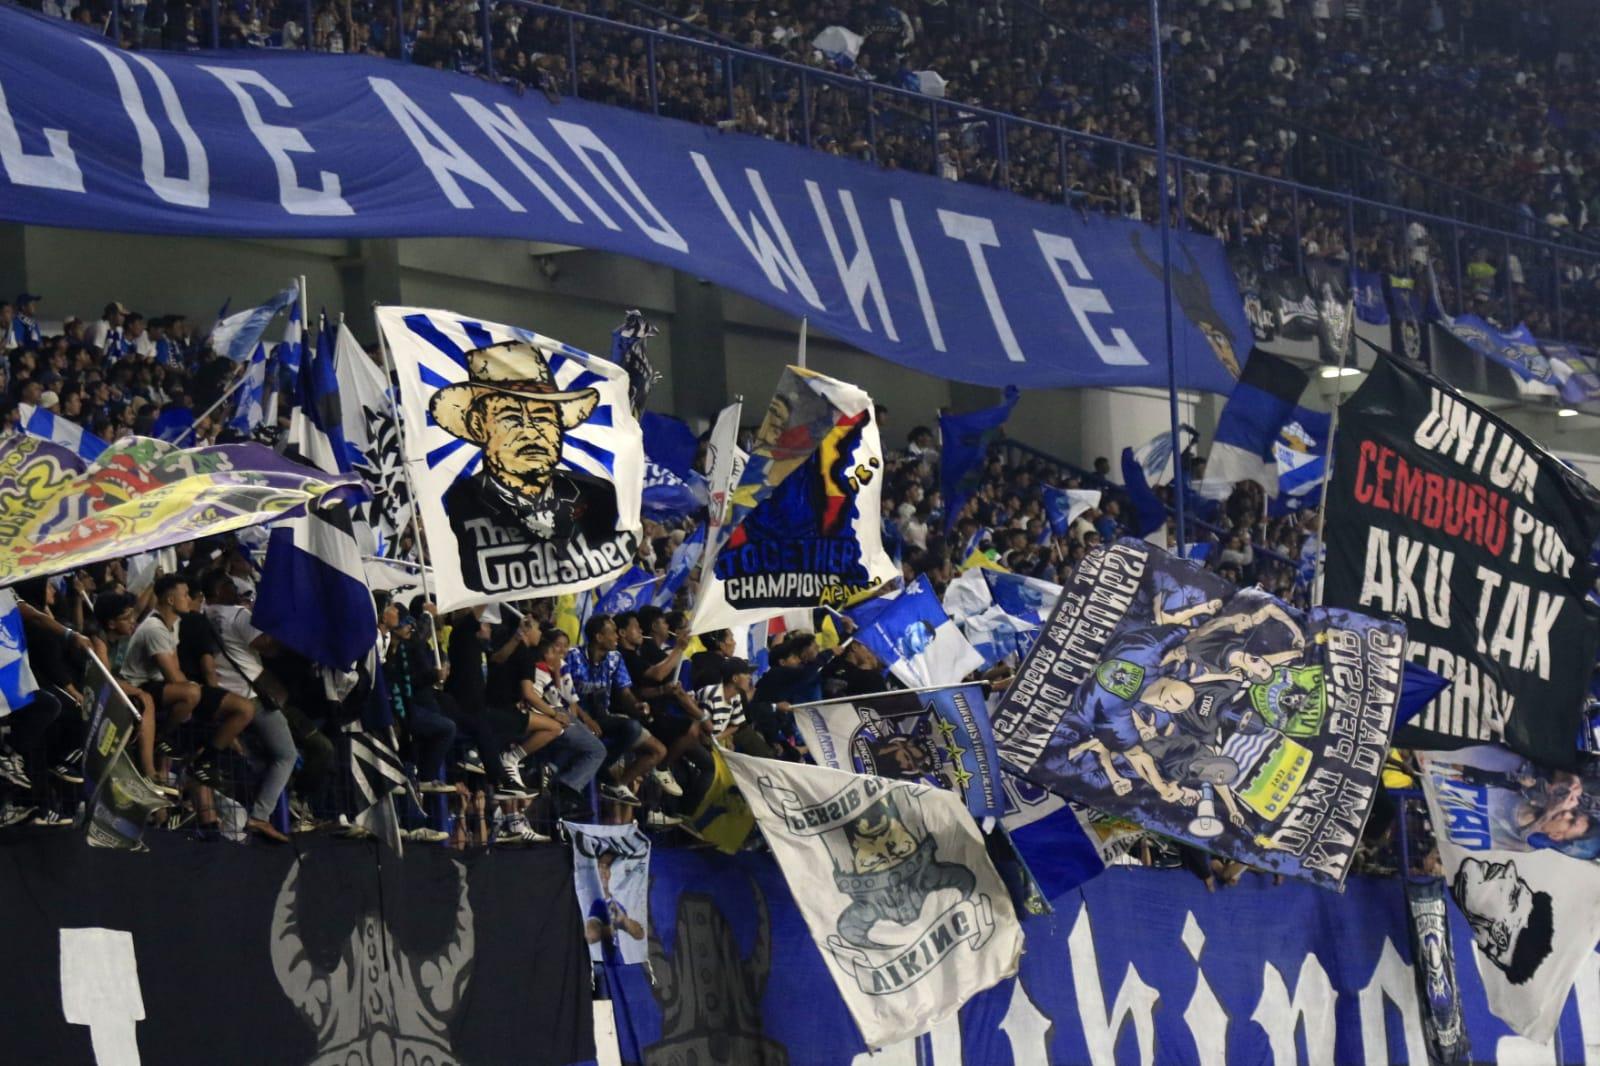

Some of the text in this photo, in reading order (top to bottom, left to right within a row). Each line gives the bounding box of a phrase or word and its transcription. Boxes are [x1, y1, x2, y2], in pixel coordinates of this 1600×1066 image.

[367, 76, 689, 253] AND
[689, 151, 1149, 365] WHITE
[464, 517, 525, 547] The
[1354, 440, 1509, 556] CEMBURU
[477, 532, 633, 591] Godfather
[1360, 525, 1564, 681] AKU TAK
